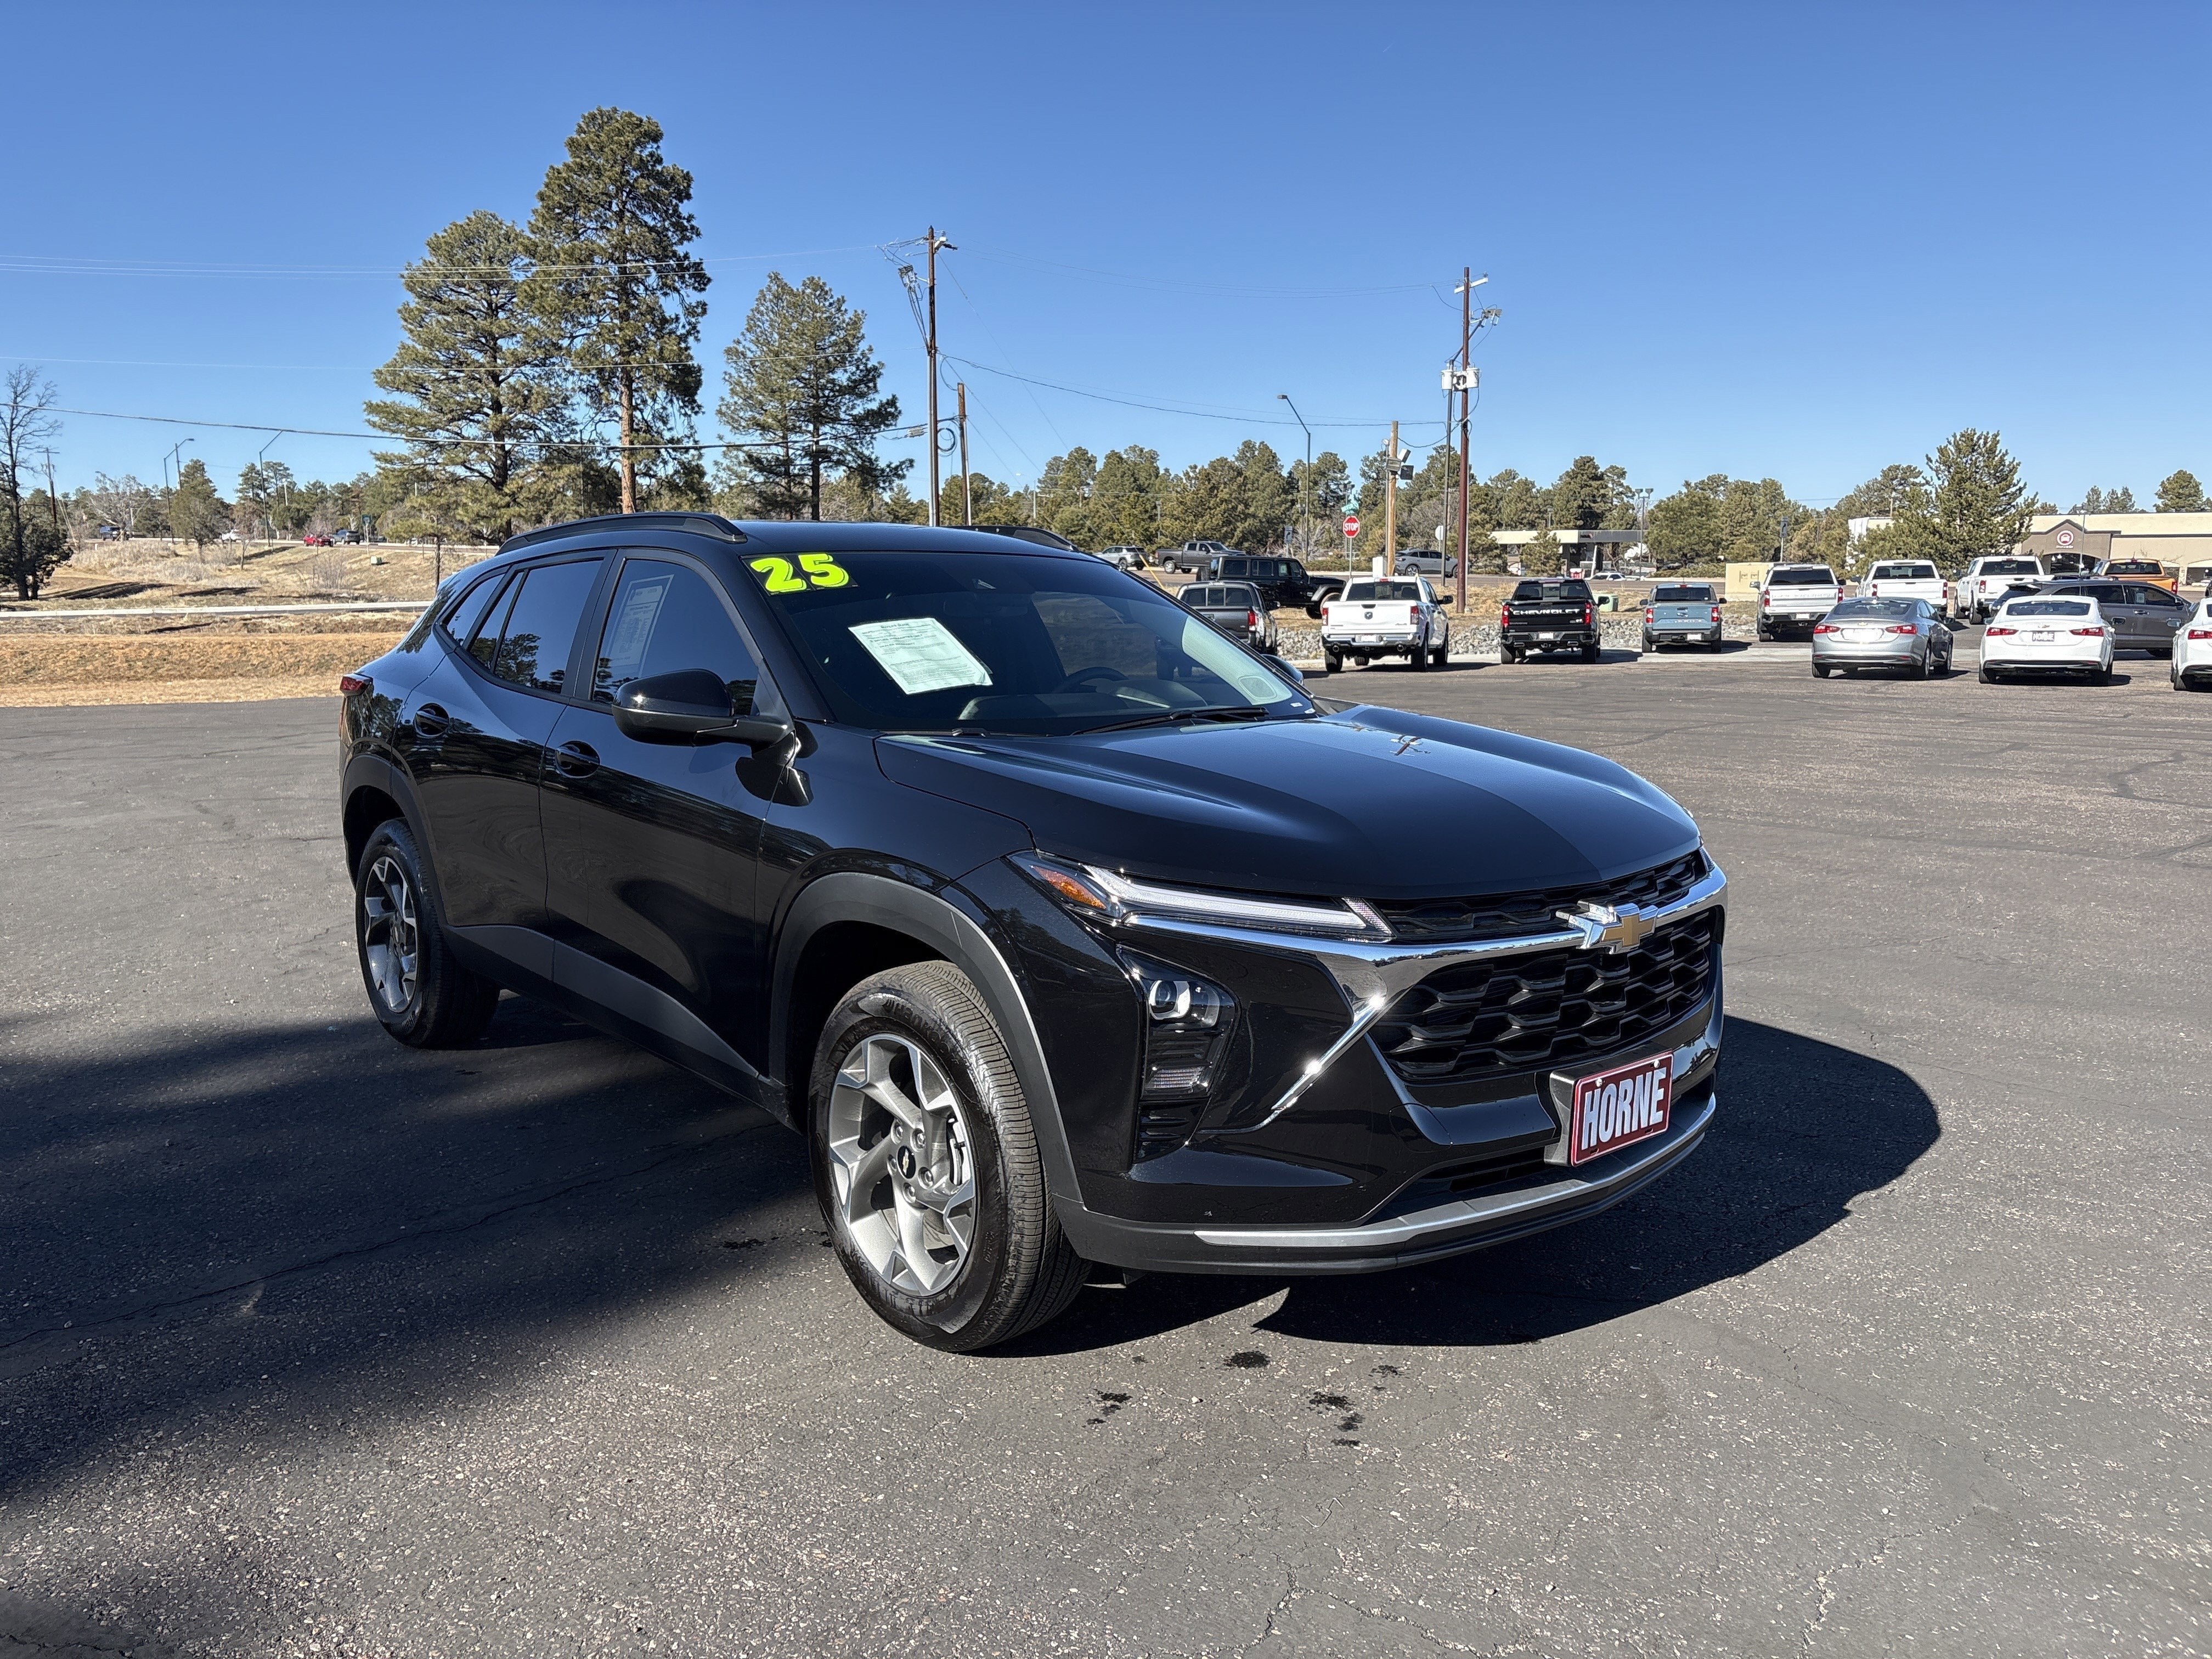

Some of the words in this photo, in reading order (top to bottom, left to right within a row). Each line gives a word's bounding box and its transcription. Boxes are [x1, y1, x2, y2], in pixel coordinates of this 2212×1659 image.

[1344, 522, 1358, 531] STOP
[750, 553, 849, 593] 25
[1582, 1067, 1667, 1150] HORNE
